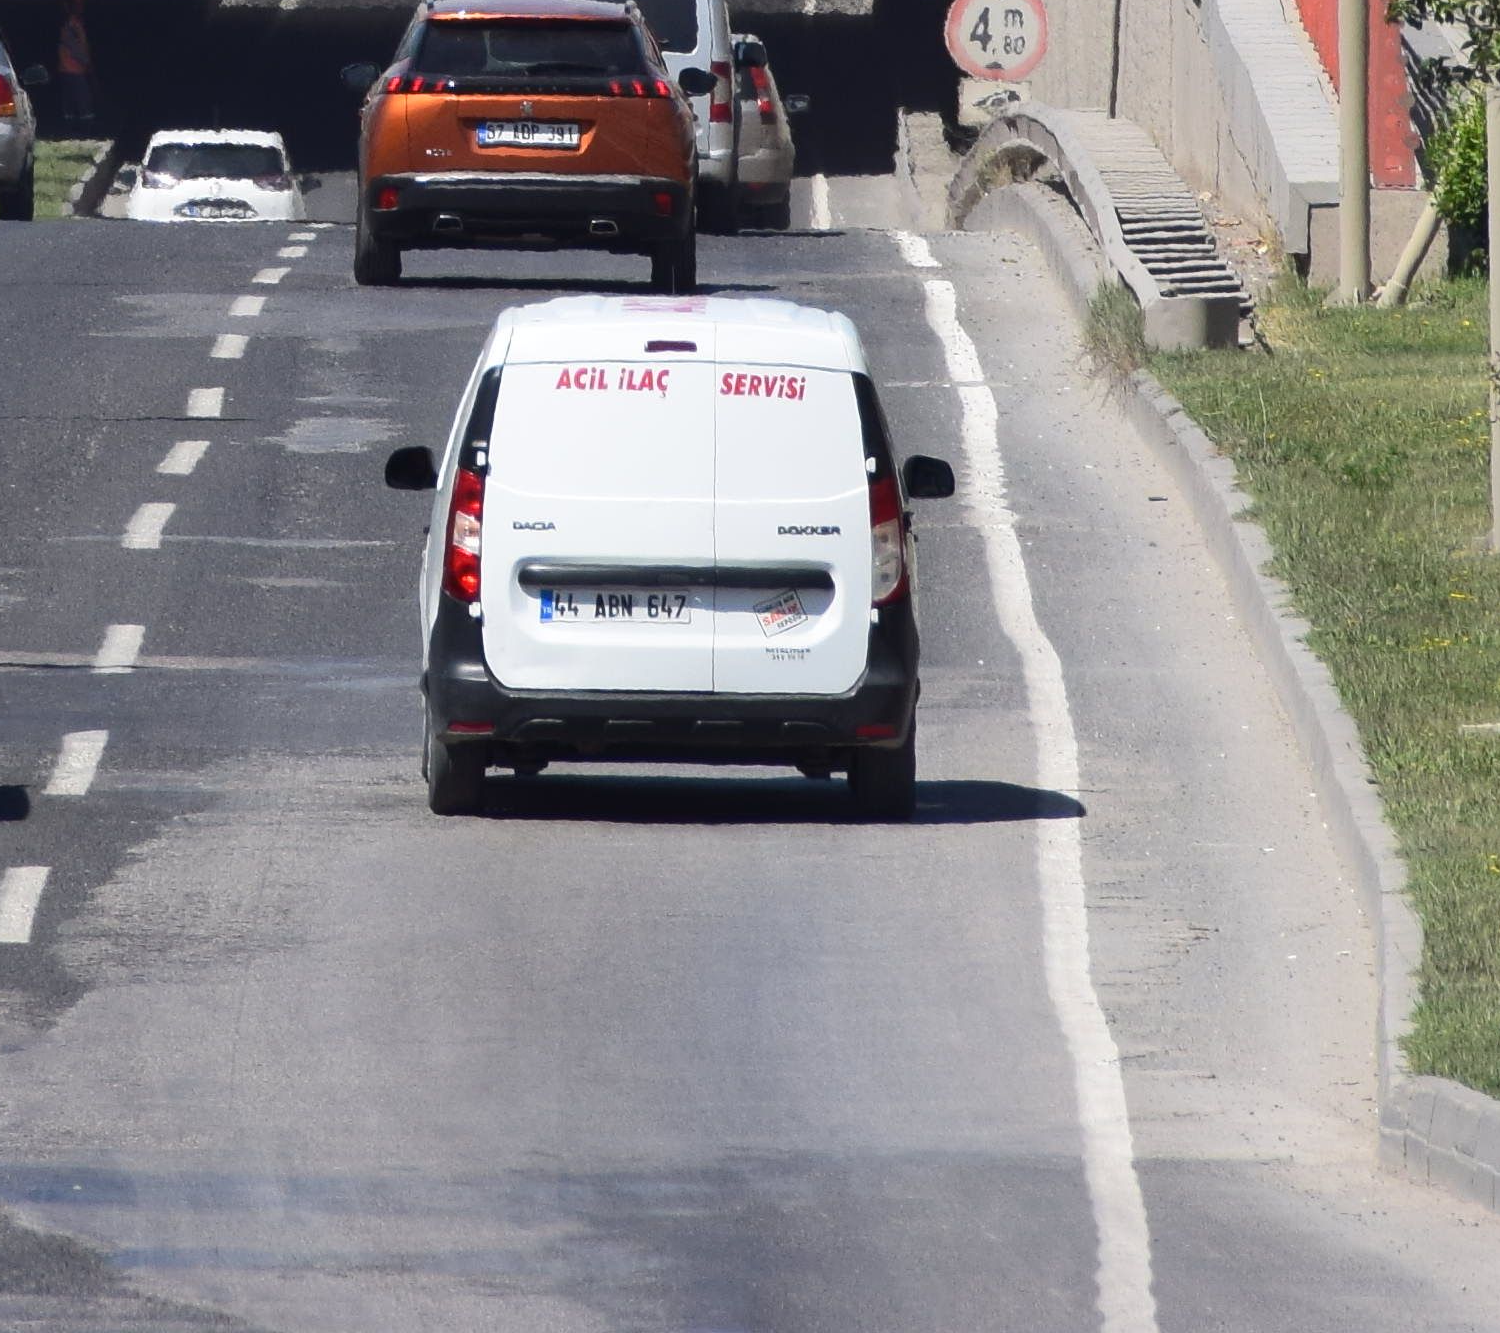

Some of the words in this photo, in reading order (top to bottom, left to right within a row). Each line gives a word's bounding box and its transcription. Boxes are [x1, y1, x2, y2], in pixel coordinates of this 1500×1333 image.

[1003, 34, 1026, 56] 80
[512, 520, 557, 532] DACIA
[776, 525, 842, 537] DOKKER
[553, 593, 579, 618] 44
[593, 593, 634, 619] ABN
[647, 593, 687, 619] 647
